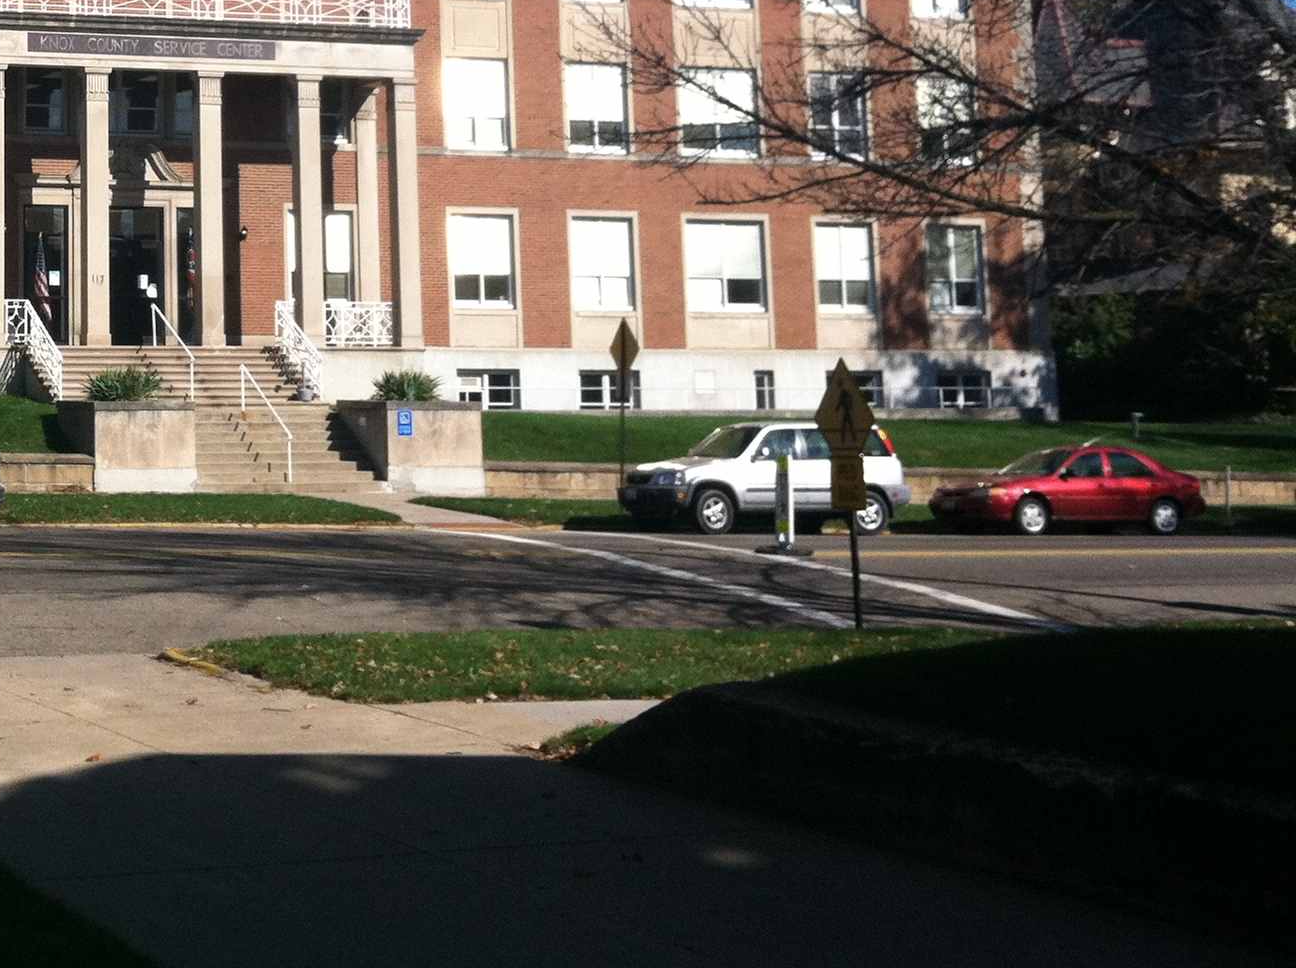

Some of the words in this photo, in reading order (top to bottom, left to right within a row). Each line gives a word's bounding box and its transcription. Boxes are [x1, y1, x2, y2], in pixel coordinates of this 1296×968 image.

[40, 36, 75, 51] KNOX
[87, 37, 139, 53] COUNTY
[154, 40, 208, 56] SERVICE
[217, 42, 263, 58] CENTER
